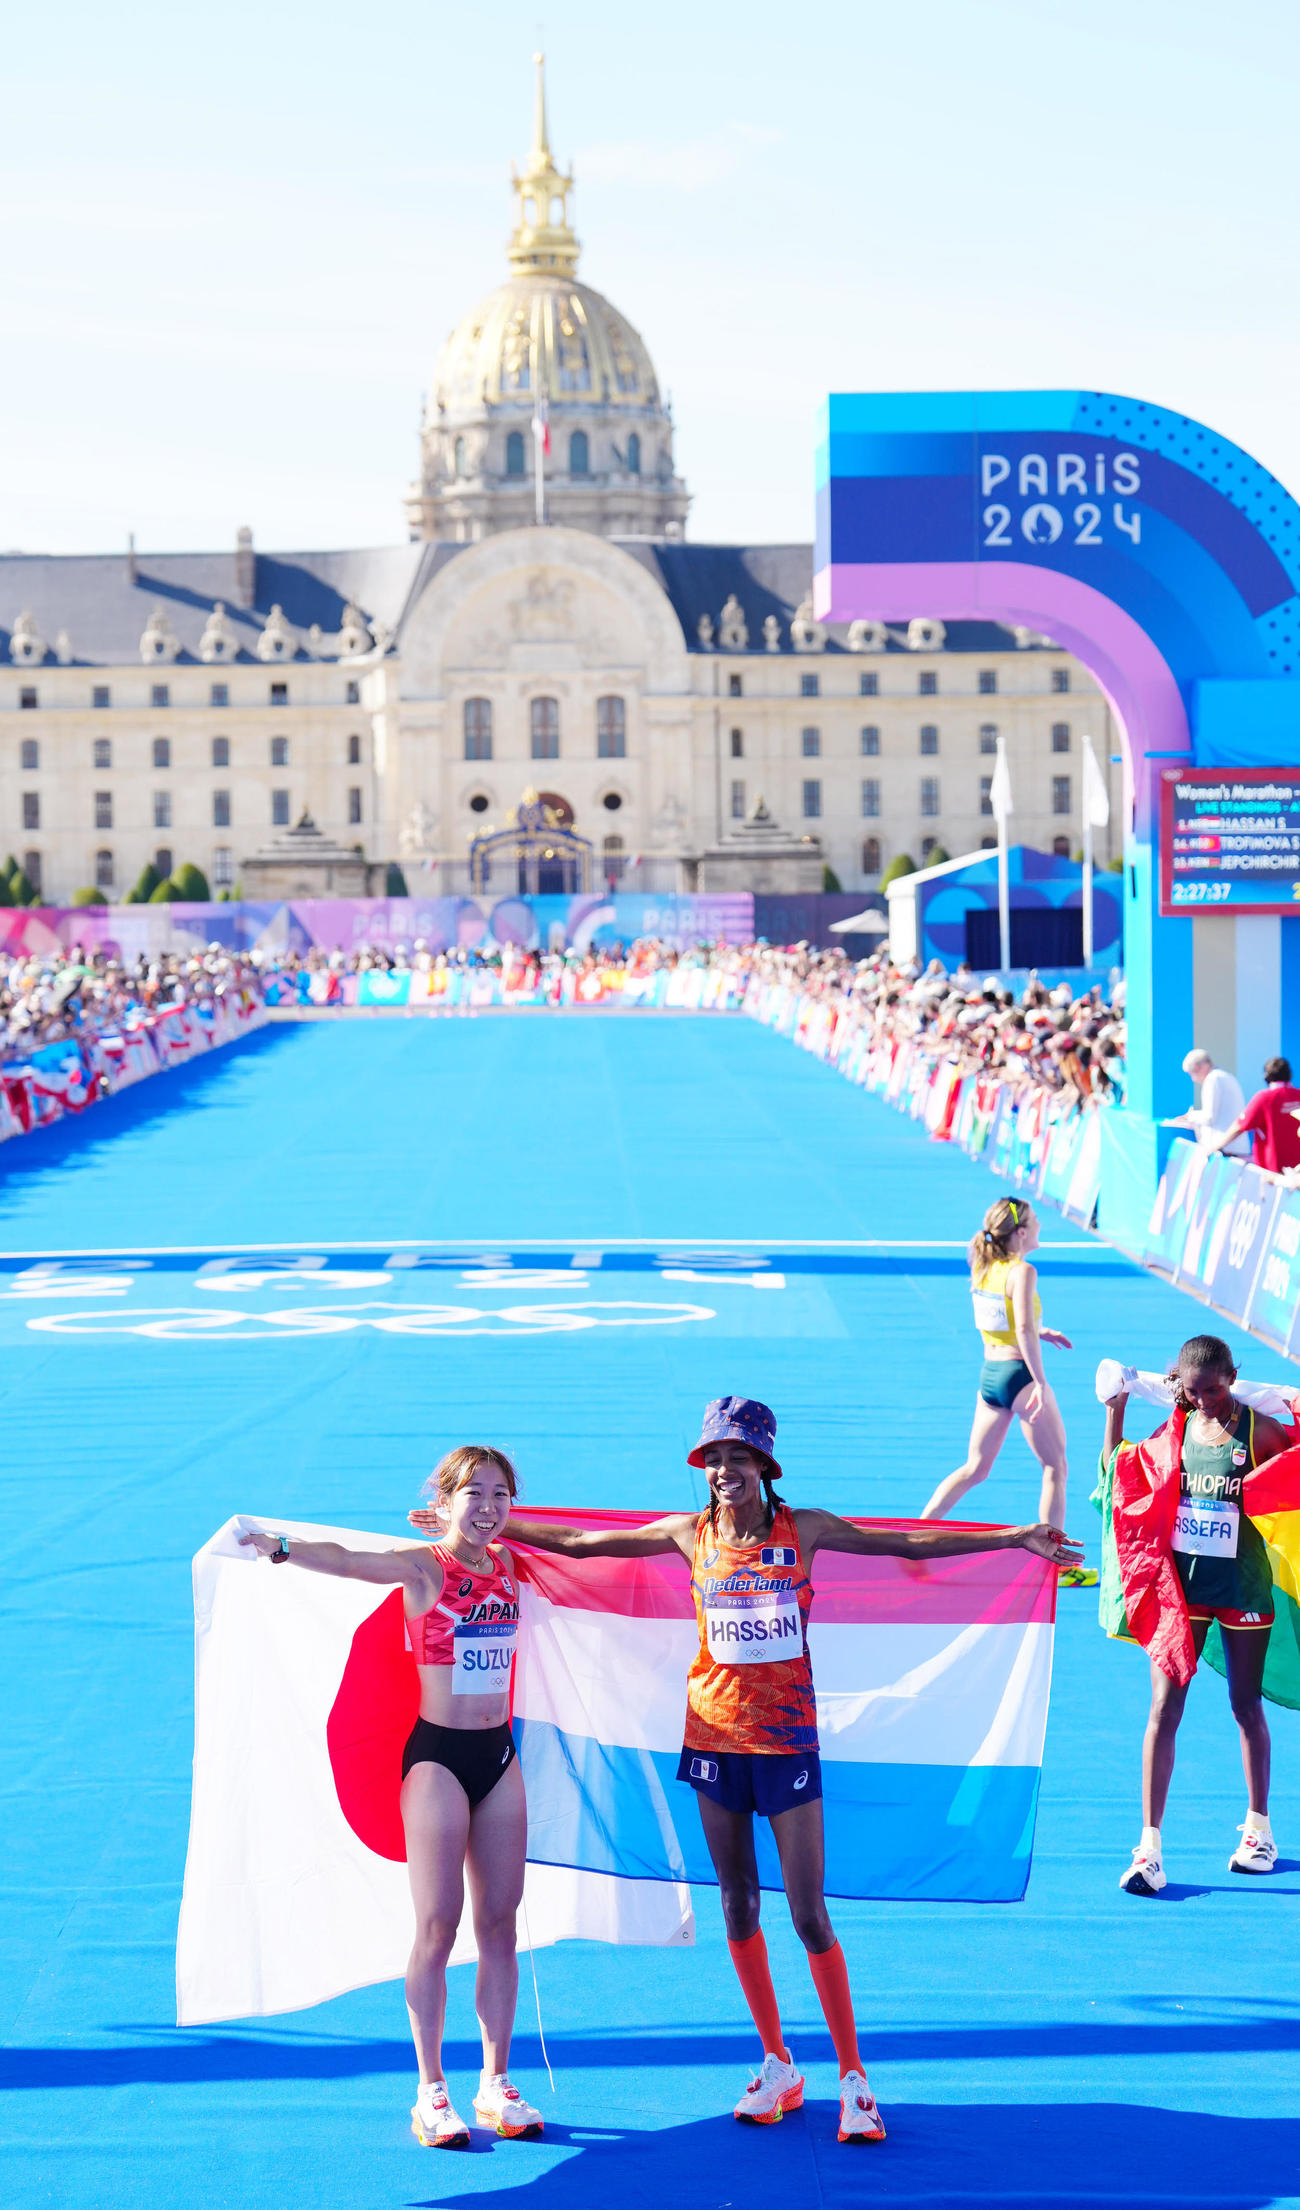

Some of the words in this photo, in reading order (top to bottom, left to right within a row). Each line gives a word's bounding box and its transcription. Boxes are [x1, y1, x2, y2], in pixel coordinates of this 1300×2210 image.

[983, 503, 1141, 546] 2024
[1175, 784, 1230, 800] Women's
[1231, 784, 1292, 800] Marathon
[1195, 801, 1219, 814] LIVE
[1220, 801, 1282, 814] STANDINGS
[1220, 817, 1275, 830] HASSAN
[1173, 883, 1232, 900] 2:27:37
[1180, 1472, 1241, 1495] THIOPIA
[1174, 1516, 1231, 1539] ASSEFA
[461, 1602, 519, 1623] JAPAN
[711, 1615, 797, 1641] HASSAN
